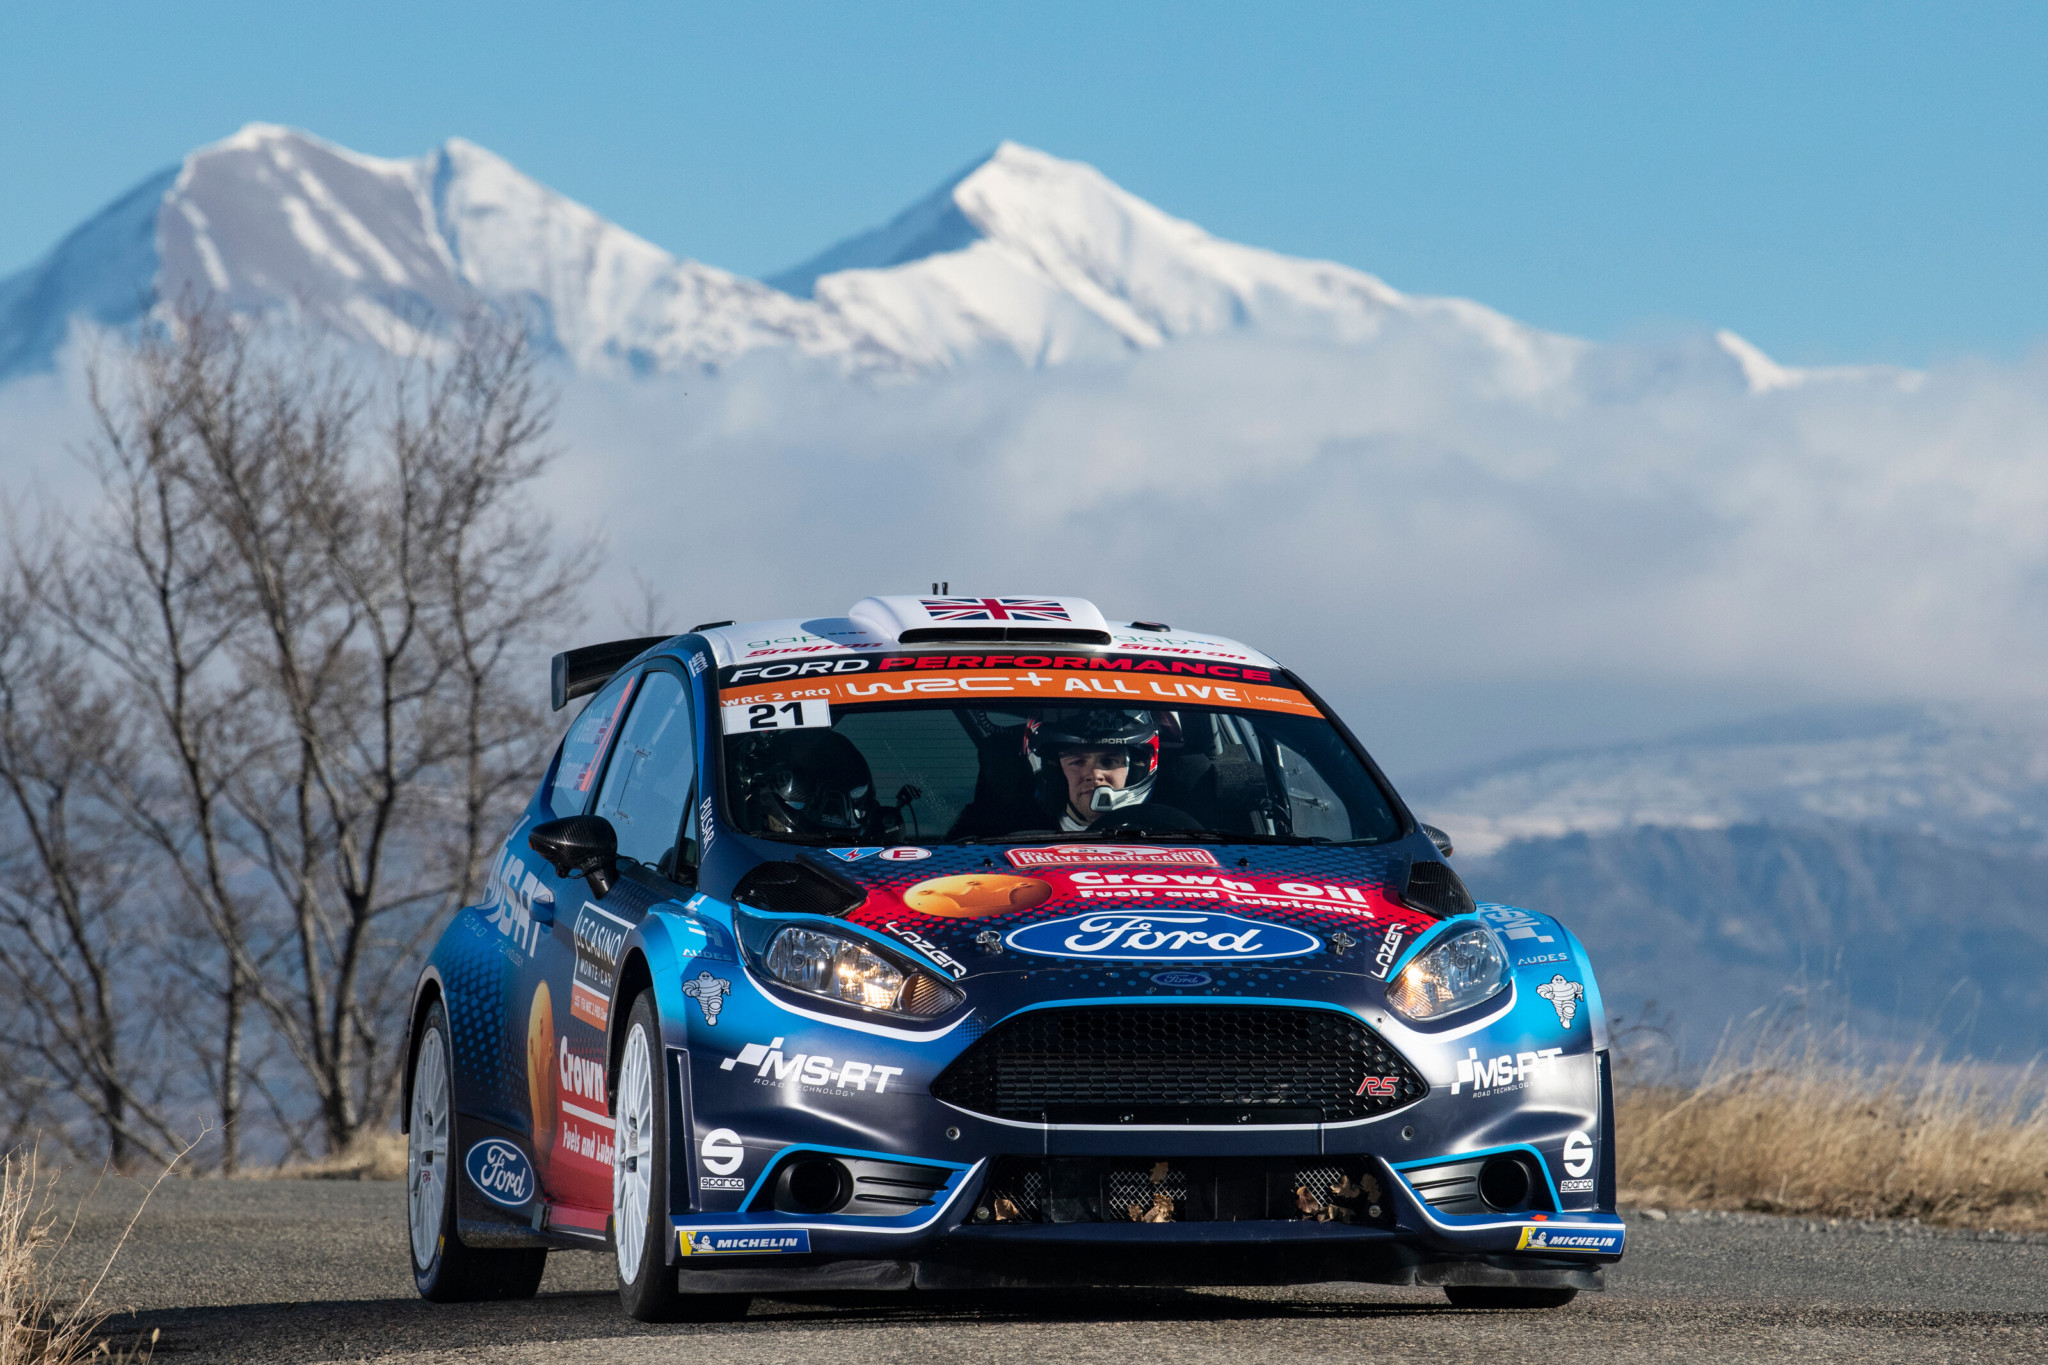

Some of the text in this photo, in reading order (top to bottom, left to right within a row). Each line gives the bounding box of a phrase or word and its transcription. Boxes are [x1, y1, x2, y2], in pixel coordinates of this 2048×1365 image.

[747, 635, 825, 649] gap
[1113, 635, 1188, 646] gap
[729, 659, 870, 683] FORD
[878, 655, 1271, 682] PERFORMANCE
[722, 688, 831, 707] WRC 2 PRO
[1065, 678, 1141, 694] ALL
[1149, 682, 1242, 702] LIVE
[748, 701, 804, 729] 21
[893, 850, 918, 859] E
[1069, 871, 1367, 903] Crown Oil
[1079, 889, 1375, 918] Fuels and Lubricants
[1064, 914, 1265, 953] Ford
[1518, 952, 1568, 966] AUDES
[1164, 974, 1199, 983] Ford
[559, 1035, 605, 1104] Crown
[753, 1077, 855, 1097] ROAD ECHNOLOGY
[1355, 1076, 1400, 1097] RS
[1472, 1090, 1491, 1099] ROAD
[581, 1130, 596, 1160] and
[480, 1145, 526, 1198] Ford
[702, 1178, 744, 1188] sparco
[1561, 1180, 1593, 1190] sparco
[716, 1238, 798, 1248] MICHELIN
[1549, 1236, 1616, 1247] MICHELIN
